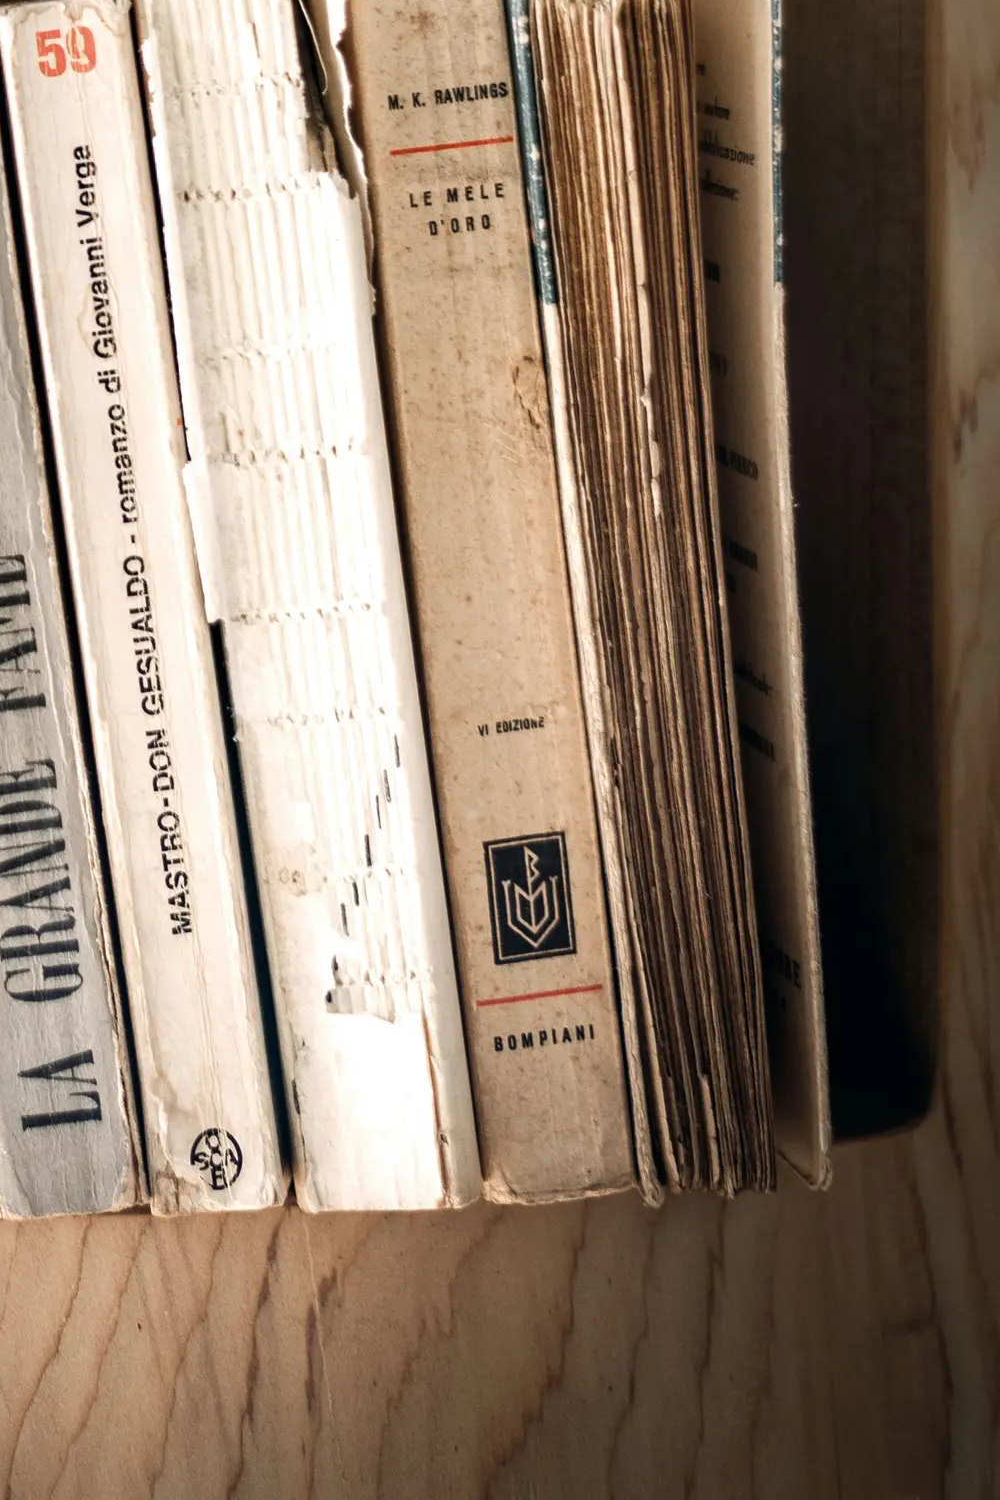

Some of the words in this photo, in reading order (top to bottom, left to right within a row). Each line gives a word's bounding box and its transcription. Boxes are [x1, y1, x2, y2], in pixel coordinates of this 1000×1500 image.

[35, 25, 97, 77] 59
[388, 94, 404, 111] M.
[411, 92, 426, 109] K.
[434, 82, 509, 105] RAWLINGS
[72, 144, 99, 228] Verga
[409, 191, 433, 208] LE
[446, 182, 505, 203] MELE
[428, 214, 491, 236] D'ORO
[79, 236, 118, 359] Giovanni
[97, 369, 121, 394] di
[108, 404, 138, 524] romanzo
[123, 555, 165, 716] GESUALDO
[477, 723, 489, 736] VI
[496, 716, 545, 734] EDIZIONE
[494, 1023, 595, 1052] BOMPIANI
[17, 1049, 103, 1132] LA
